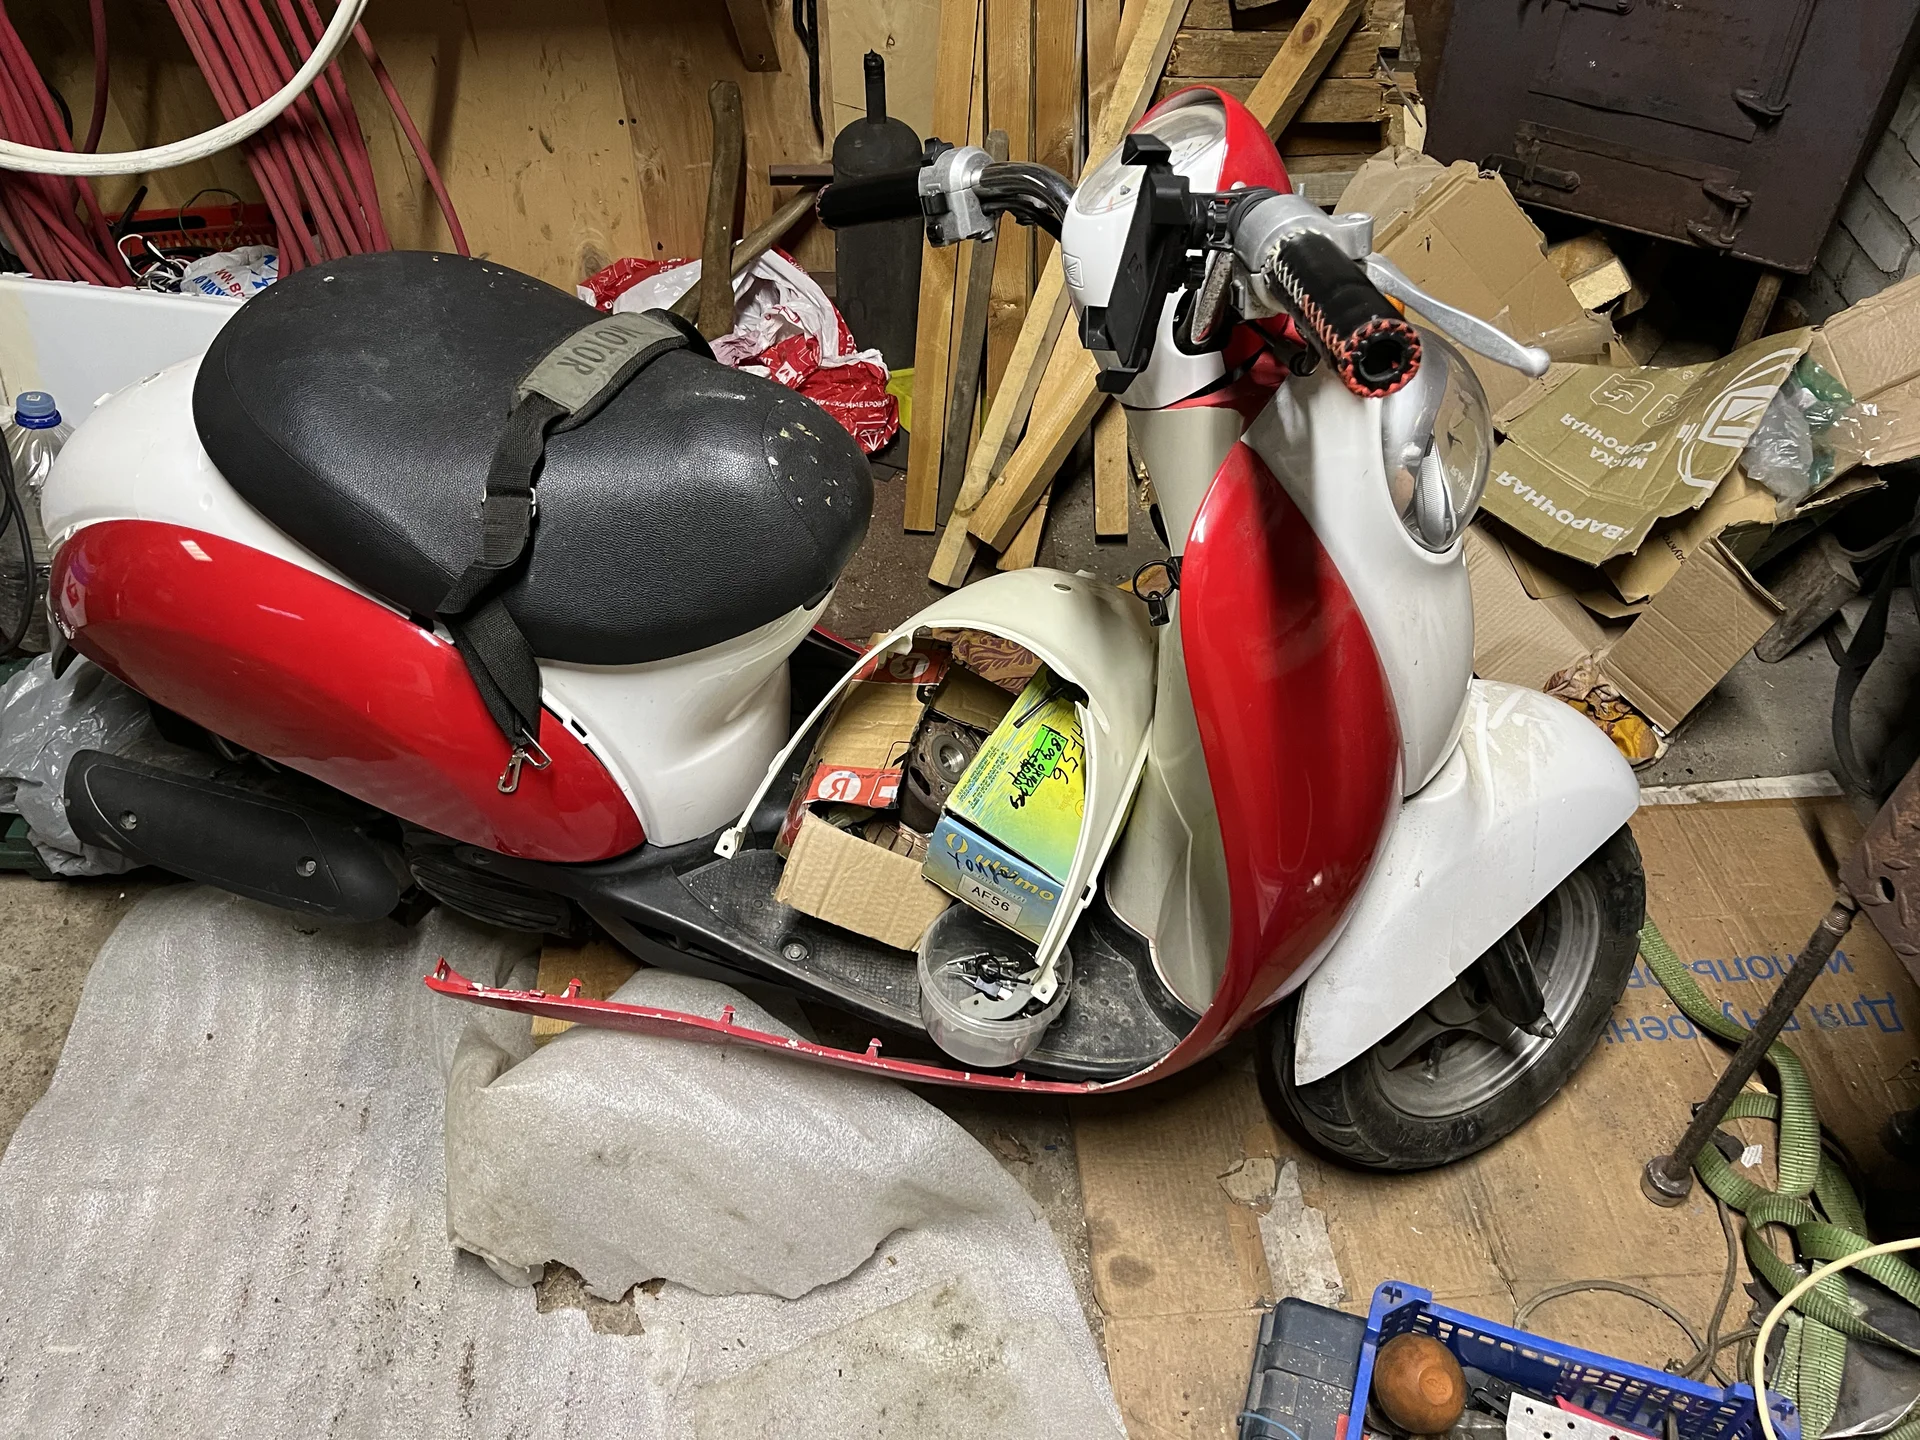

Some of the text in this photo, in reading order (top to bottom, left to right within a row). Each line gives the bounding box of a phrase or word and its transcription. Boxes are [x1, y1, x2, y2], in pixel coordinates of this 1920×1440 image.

[556, 327, 644, 376] MOTOR
[1560, 413, 1657, 453] СВАРОЧНАЯ
[1589, 446, 1647, 469] МАСКА
[1495, 471, 1633, 539] ВАРОЧНАЯ
[971, 886, 1010, 912] AF56
[1809, 992, 1904, 1033] Для
